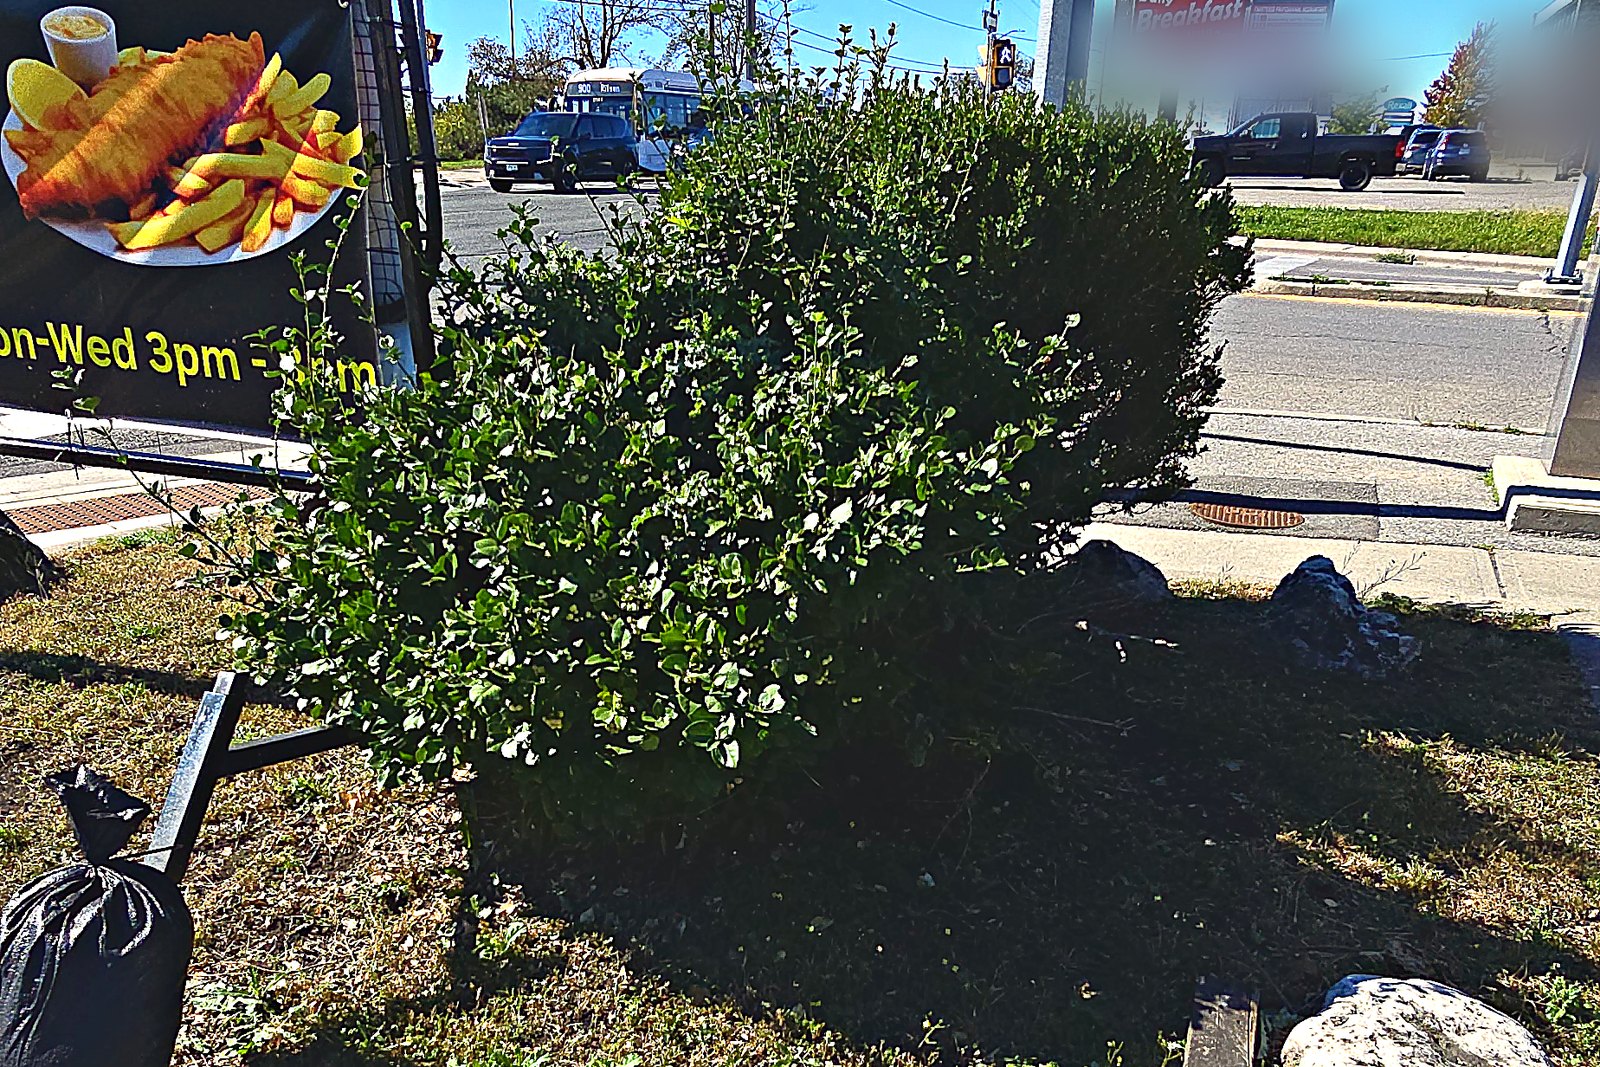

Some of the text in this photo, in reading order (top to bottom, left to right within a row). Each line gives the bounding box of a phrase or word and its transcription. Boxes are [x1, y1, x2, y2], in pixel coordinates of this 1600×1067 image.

[1137, 0, 1243, 32] Breakfast
[577, 83, 591, 93] 900
[145, 330, 242, 388] 3pm
